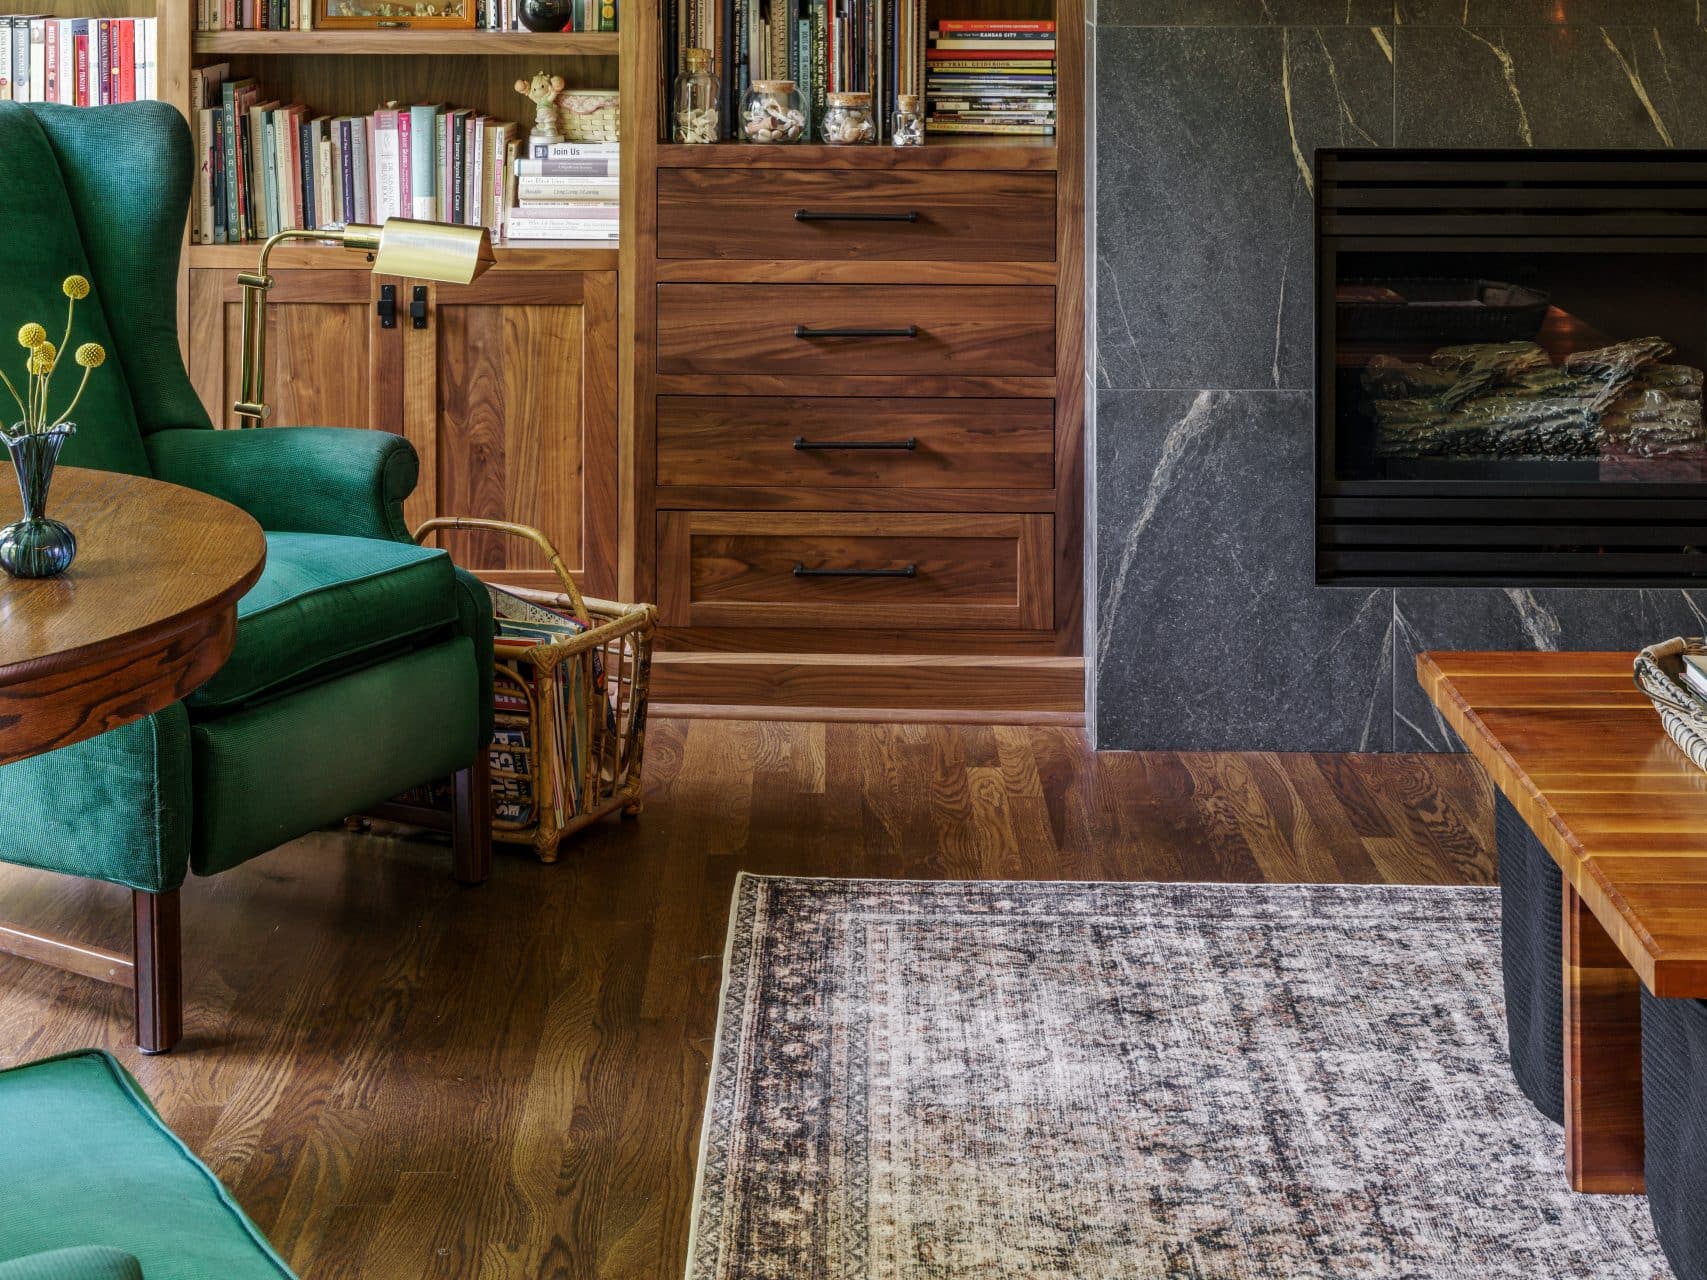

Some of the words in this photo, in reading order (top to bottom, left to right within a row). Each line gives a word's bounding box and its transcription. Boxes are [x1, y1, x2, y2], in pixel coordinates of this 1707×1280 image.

[101, 31, 109, 56] ADRIANA
[778, 0, 786, 53] NANTUCKET
[778, 56, 786, 81] ISLAN
[225, 103, 238, 222] RADIOACTIVE
